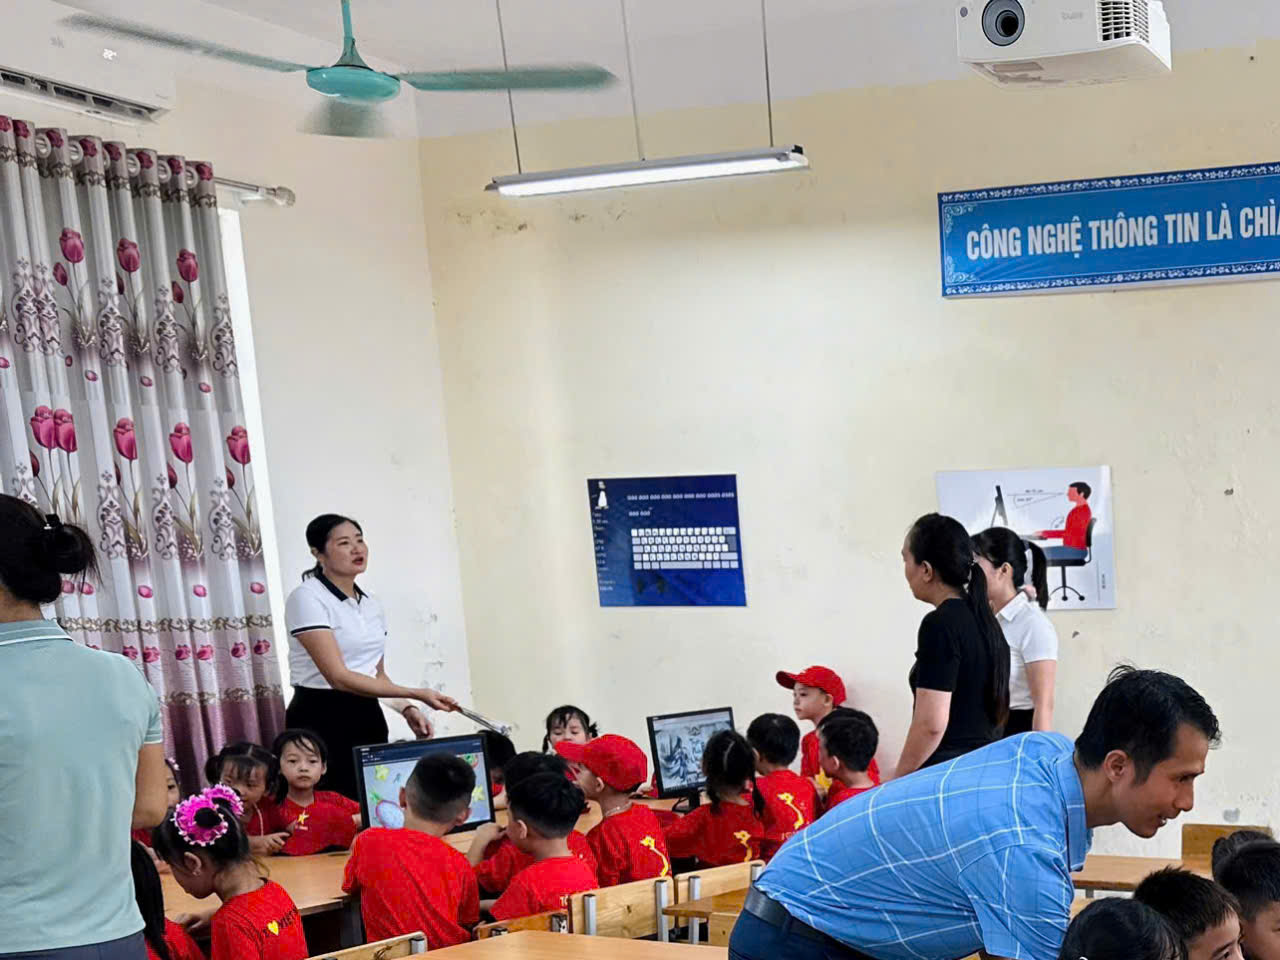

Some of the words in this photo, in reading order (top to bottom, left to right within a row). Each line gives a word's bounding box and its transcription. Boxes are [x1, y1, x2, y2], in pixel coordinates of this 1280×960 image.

[966, 223, 1022, 261] CÔNG
[1027, 215, 1083, 258] NGHỆ
[1088, 211, 1158, 250] THÔNG
[1164, 212, 1199, 244] TIN
[1206, 202, 1233, 241] LÀ
